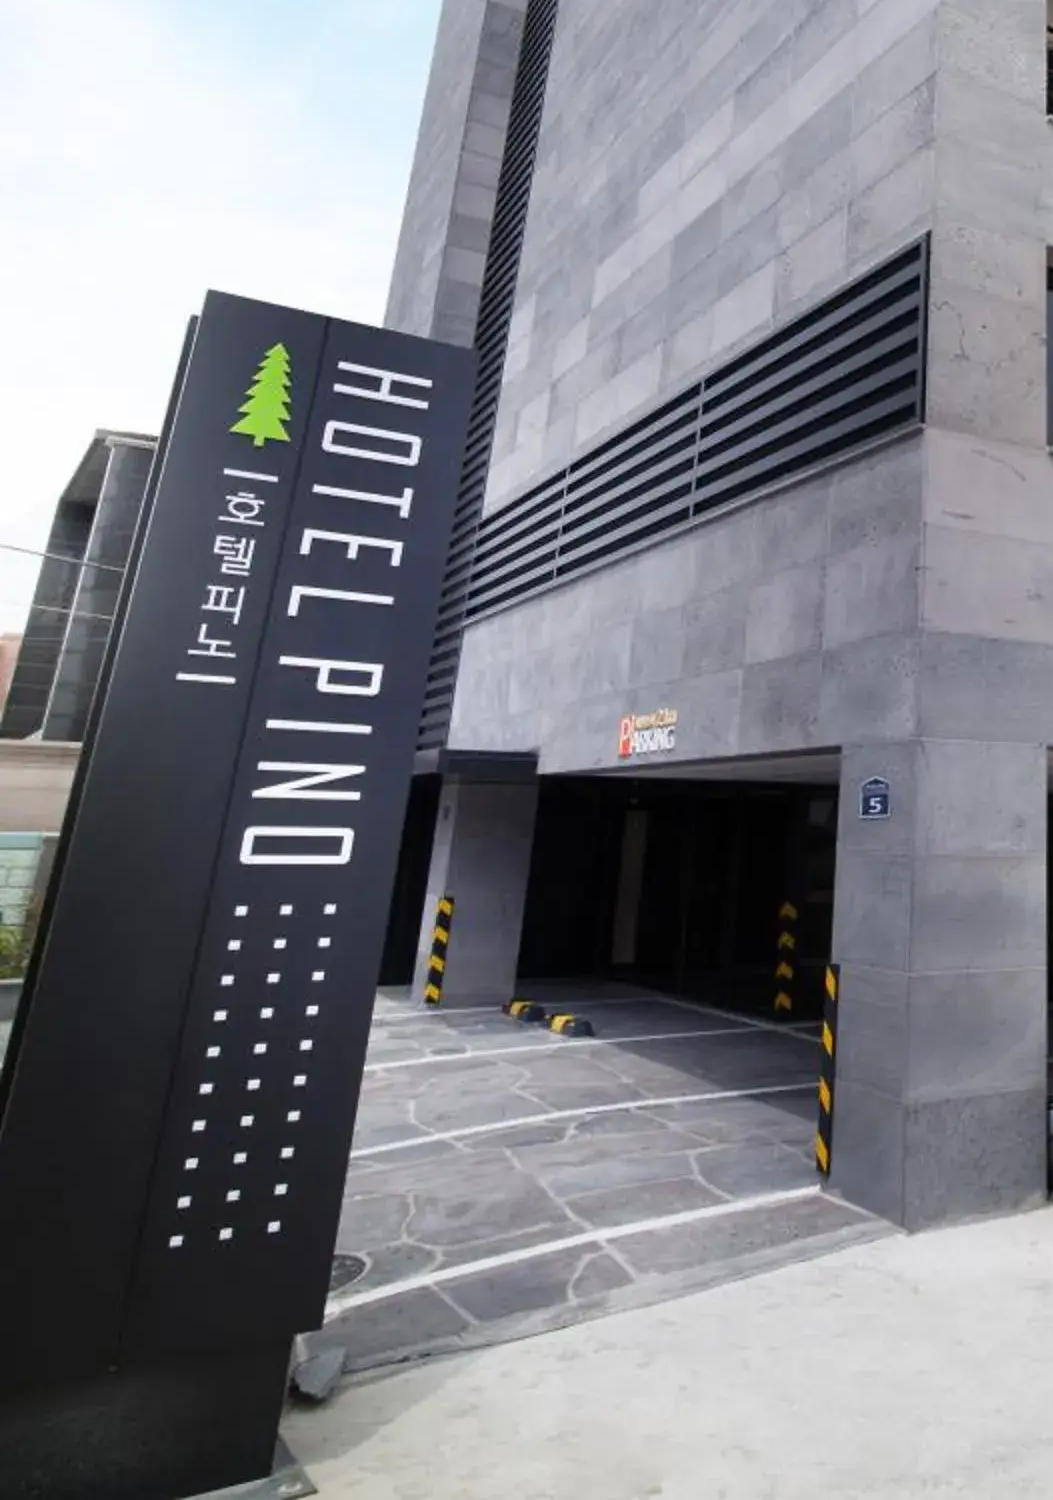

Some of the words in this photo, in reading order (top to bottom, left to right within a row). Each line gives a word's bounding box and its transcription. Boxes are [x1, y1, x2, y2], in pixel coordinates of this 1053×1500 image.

[187, 492, 265, 659] 호텔피노
[287, 360, 433, 618] HOTEL
[239, 654, 385, 866] PINO
[868, 797, 882, 813] 5
